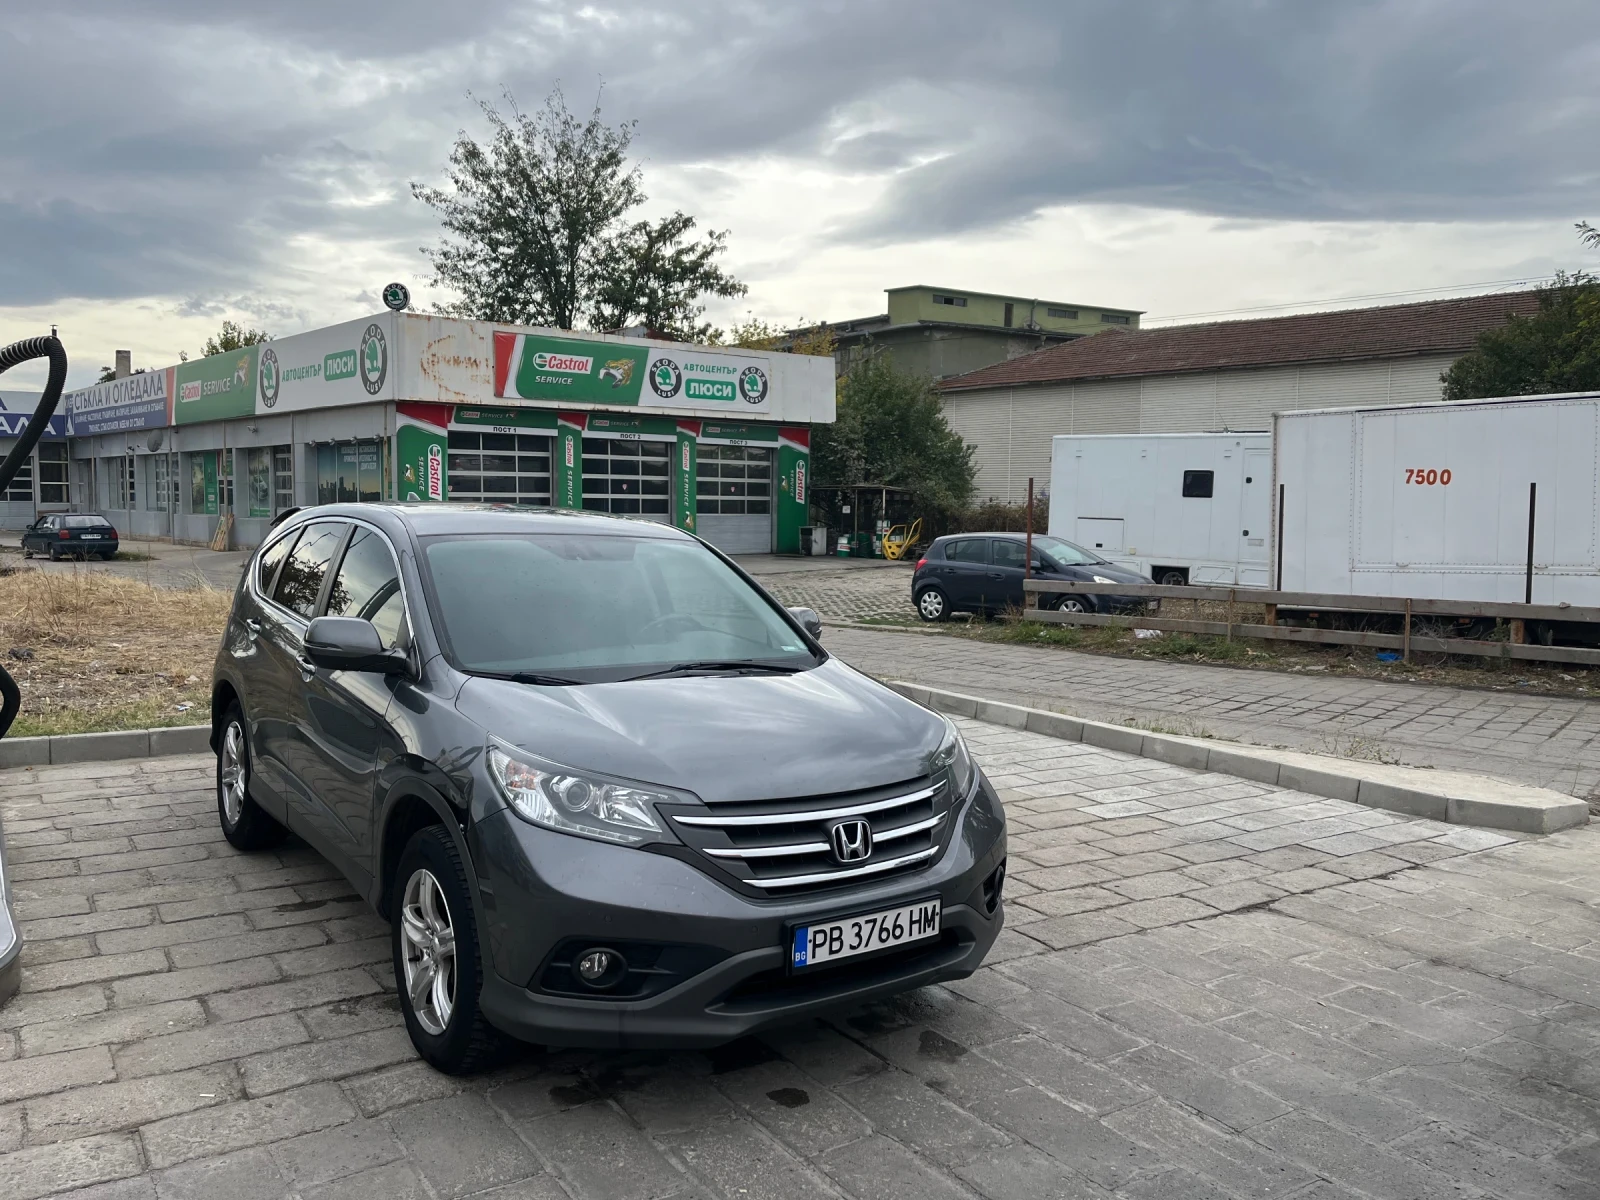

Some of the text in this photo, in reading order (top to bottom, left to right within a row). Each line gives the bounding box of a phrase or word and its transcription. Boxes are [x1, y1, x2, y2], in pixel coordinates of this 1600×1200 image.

[362, 325, 385, 351] SKODA
[261, 350, 278, 370] SKODA
[282, 355, 354, 382] АВТОЦЕНТЪР ЛЮСИ
[548, 355, 589, 372] Castrol
[651, 359, 679, 376] SKODA
[683, 363, 737, 375] АВТОЦЕНТЪР
[740, 367, 766, 382] SKODA
[203, 377, 231, 395] SERVICE
[366, 379, 381, 393] LUSI
[535, 375, 573, 385] SERVICE
[75, 388, 103, 411] СТЪКЛА
[105, 386, 111, 405] И
[113, 373, 164, 403] ОГЛЕДАЛА
[689, 382, 732, 397] ЛЮСИ
[746, 395, 762, 403] LUSI
[429, 457, 441, 496] Castrol
[1405, 468, 1452, 485] 7500
[797, 470, 805, 501] Castrol
[795, 904, 937, 962] BG PB 3766 HM
